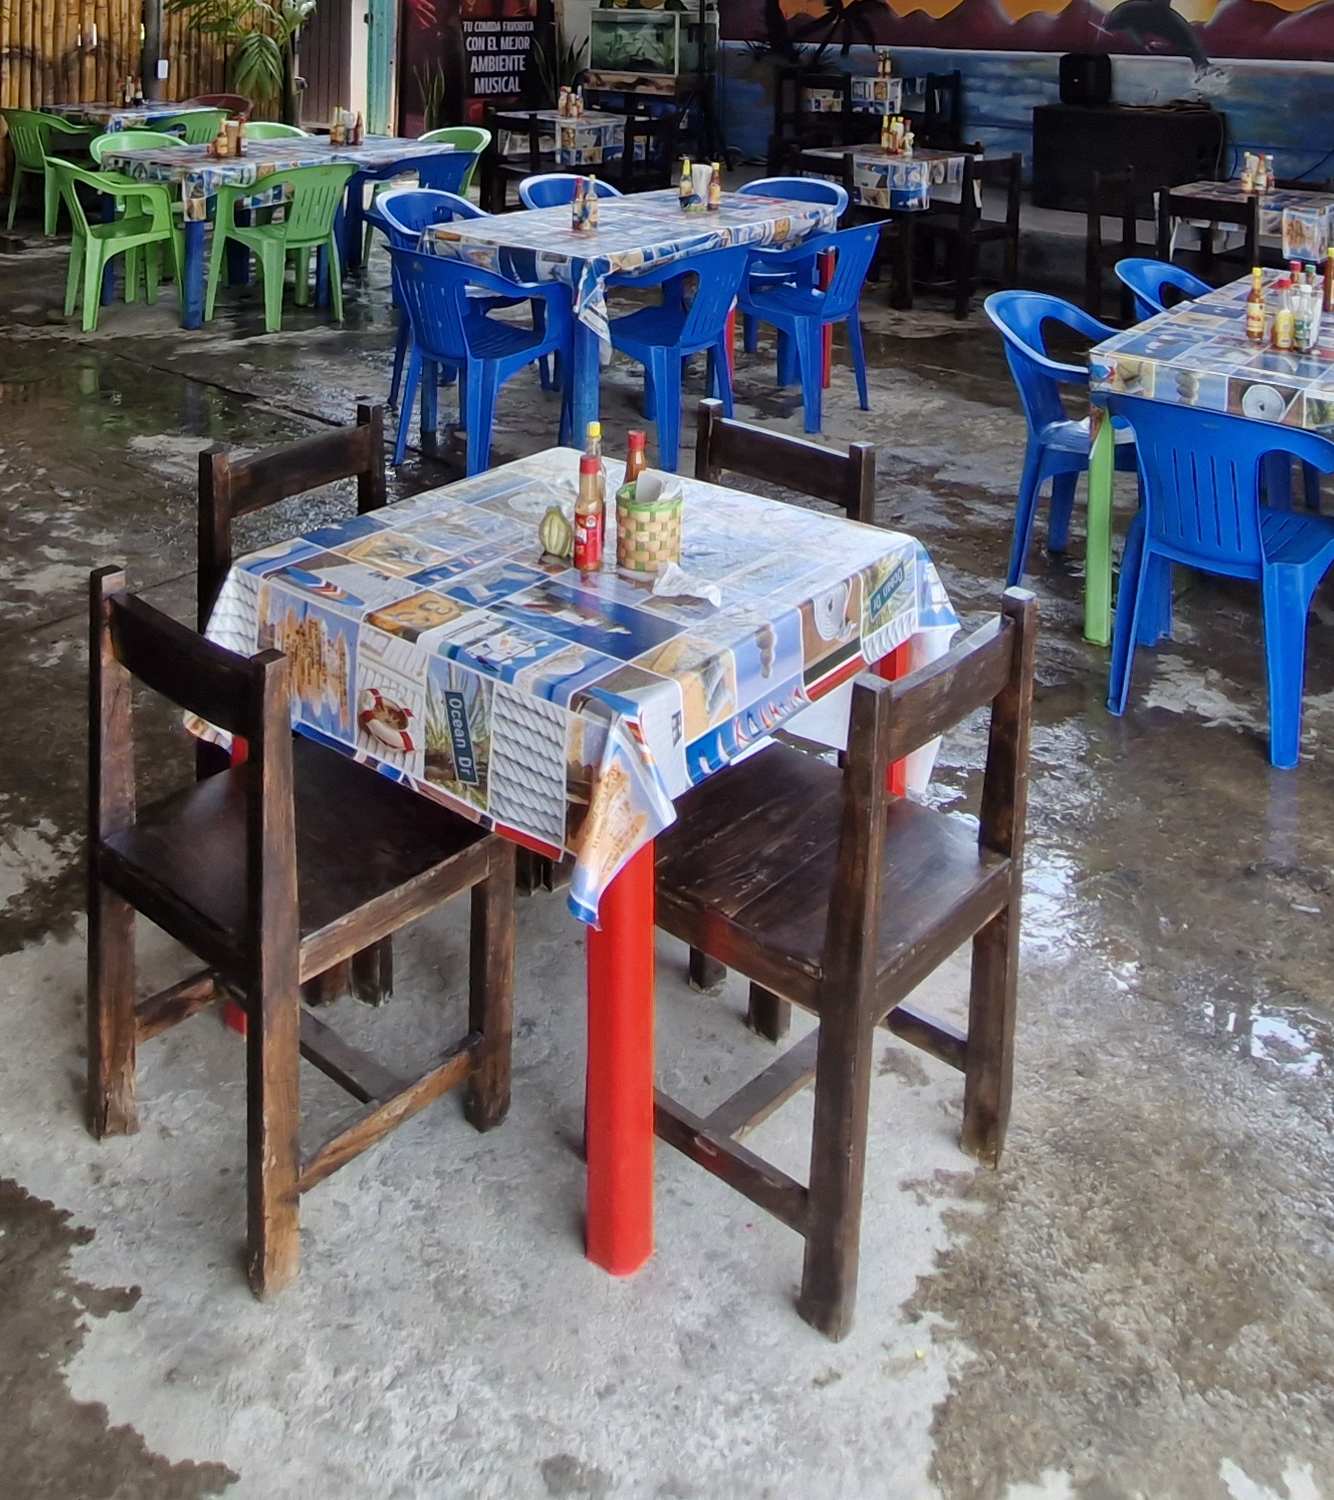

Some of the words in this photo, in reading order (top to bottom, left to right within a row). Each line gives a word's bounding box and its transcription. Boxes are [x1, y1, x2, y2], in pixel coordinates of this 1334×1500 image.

[463, 21, 473, 32] TU
[466, 36, 485, 51] CON
[487, 36, 498, 51] EL
[500, 36, 530, 50] MEJOR
[470, 55, 526, 73] AMBIENTE
[475, 76, 521, 94] MUSICAL
[448, 698, 466, 749] Ocean
[458, 756, 472, 776] Dr
